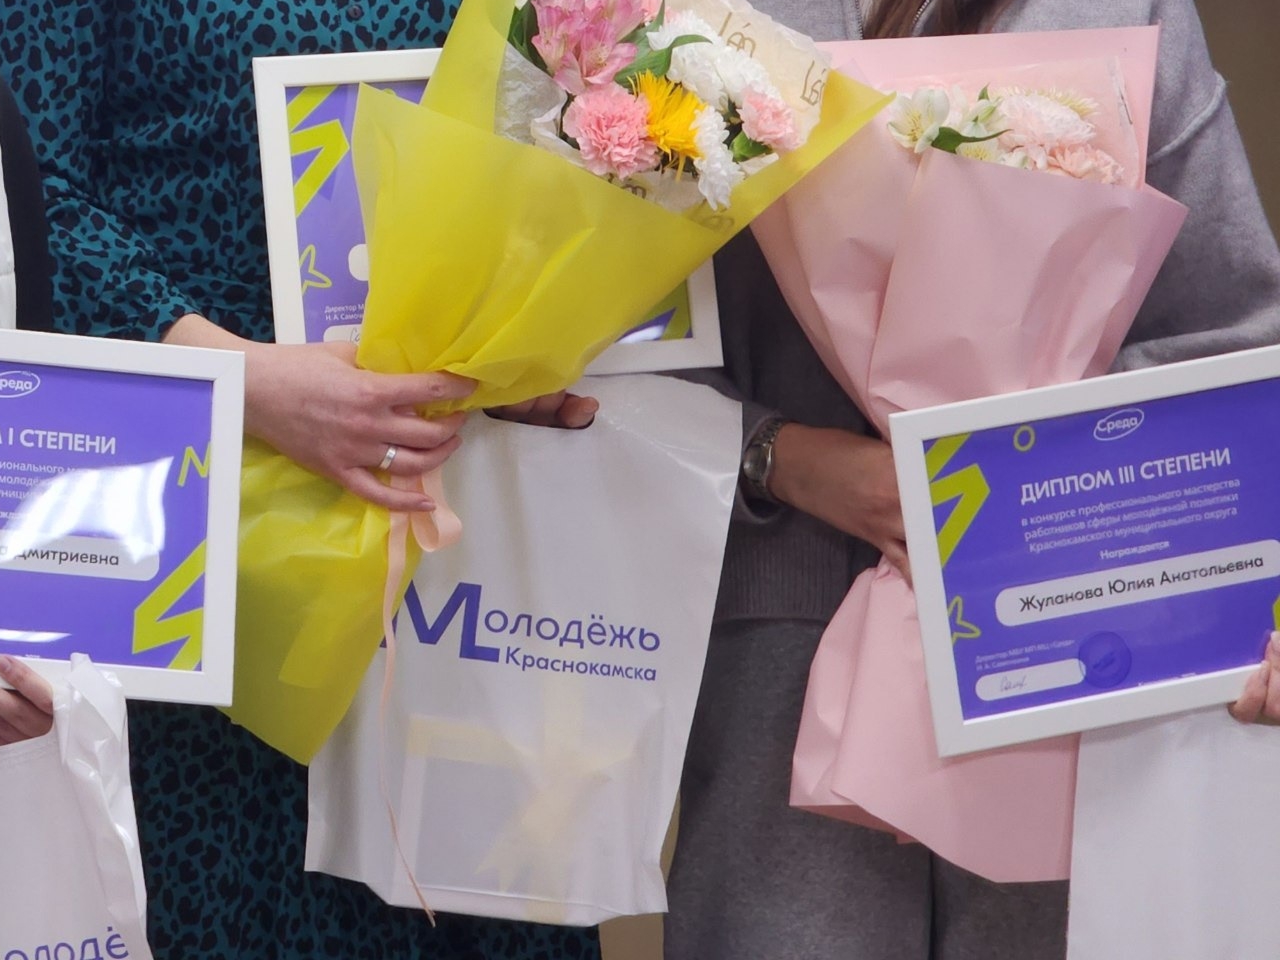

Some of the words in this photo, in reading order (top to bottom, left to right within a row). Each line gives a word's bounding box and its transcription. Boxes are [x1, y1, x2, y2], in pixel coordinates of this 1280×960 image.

[1097, 416, 1138, 433] Среда
[20, 429, 116, 455] СТЕПЕНИ
[1020, 469, 1114, 505] ДИПЛОМ
[1119, 465, 1135, 484] III
[1140, 447, 1231, 479] СТЕПЕНИ
[1030, 508, 1076, 526] конкурсе
[1078, 489, 1182, 517] профессионального
[1183, 478, 1240, 497] мастерства
[1204, 506, 1238, 523] округа
[1024, 520, 1086, 541] работников
[1087, 513, 1121, 530] сферы
[1020, 585, 1104, 613] Жуланова
[1108, 573, 1155, 596] Юлия
[1160, 555, 1264, 587] Анатольевна
[505, 646, 657, 681] Краснокамска
